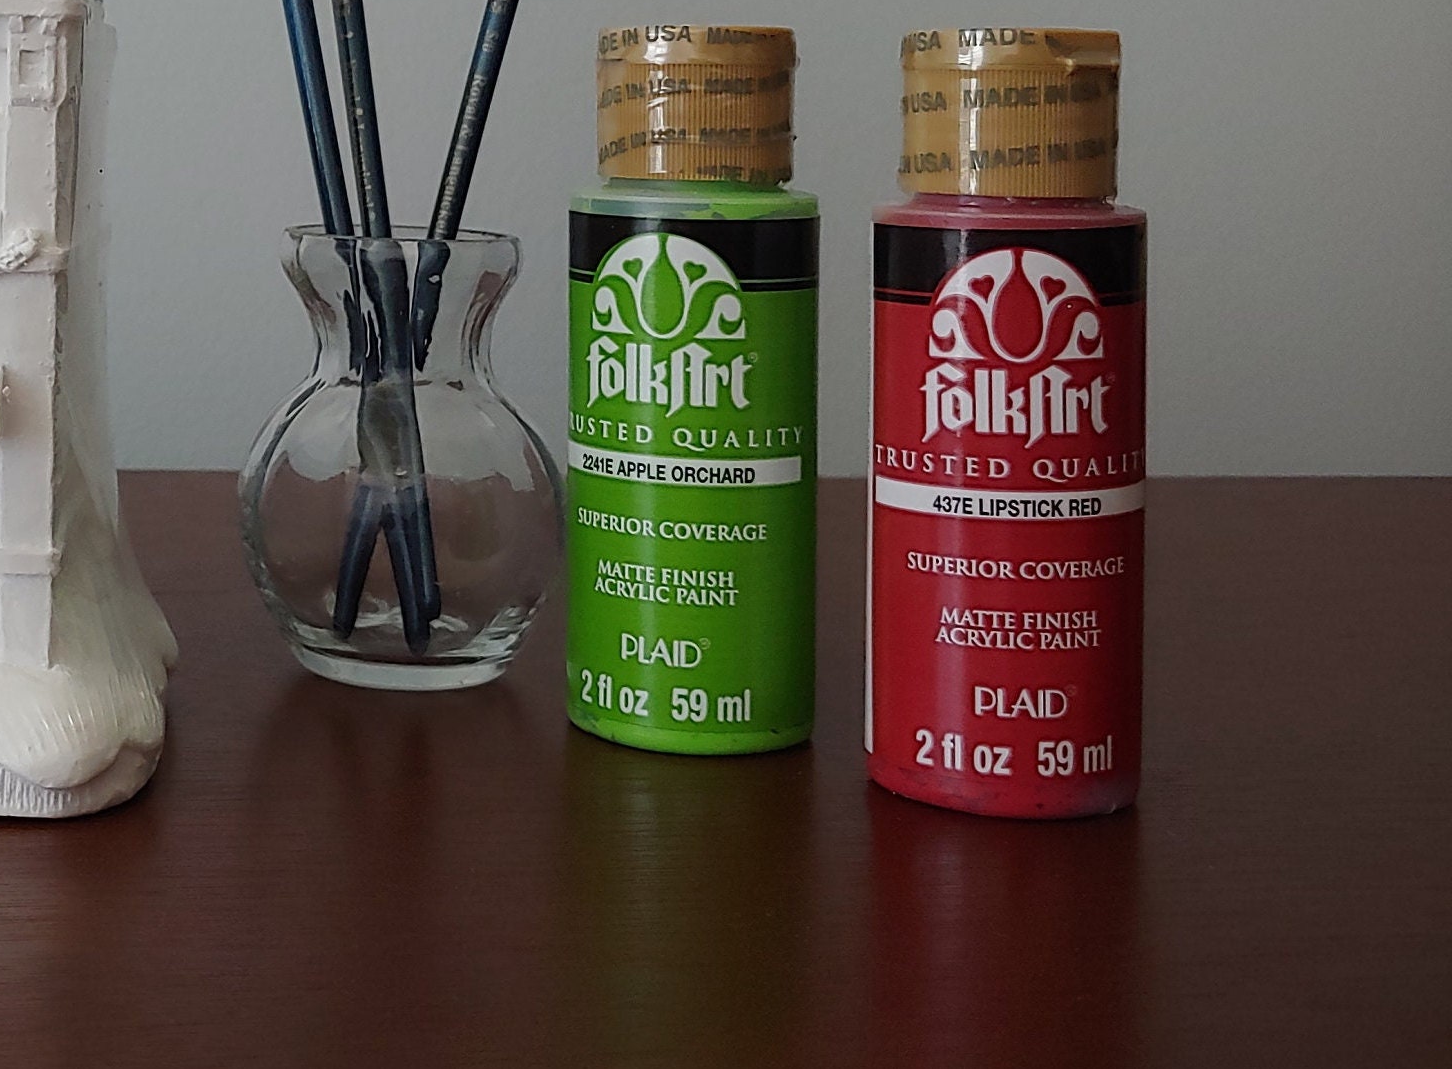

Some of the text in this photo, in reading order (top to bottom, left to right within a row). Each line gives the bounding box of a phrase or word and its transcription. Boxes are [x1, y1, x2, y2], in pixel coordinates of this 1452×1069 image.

[599, 31, 618, 56] DE
[622, 27, 639, 48] IN
[645, 25, 692, 43] USA
[957, 27, 1036, 49] MADE
[910, 91, 948, 113] USA
[963, 86, 1038, 110] MADE
[914, 152, 953, 174] USA
[970, 144, 1041, 170] MADE
[672, 426, 803, 452] QUALITY
[582, 453, 756, 484] 2241E APPLE ORCHARD
[875, 443, 1011, 479] TRUSTED
[932, 494, 1102, 518] 437E LIPSTICK RED
[577, 506, 767, 541] SUPERIOR COVERAGE
[597, 558, 734, 588] MATTE FINISH
[907, 551, 1125, 580] SUPERIOR COVERAGE
[595, 578, 740, 606] ACRYLIC PAINT
[939, 606, 1098, 630] MATTE FINISH
[620, 633, 702, 669] PLAID
[935, 627, 1102, 650] ACRYLIC PAINT
[580, 669, 752, 723] 2 fl oz 59 ml
[974, 685, 1068, 720] PLAID
[914, 729, 1113, 777] 2 fl oz 59 ml
